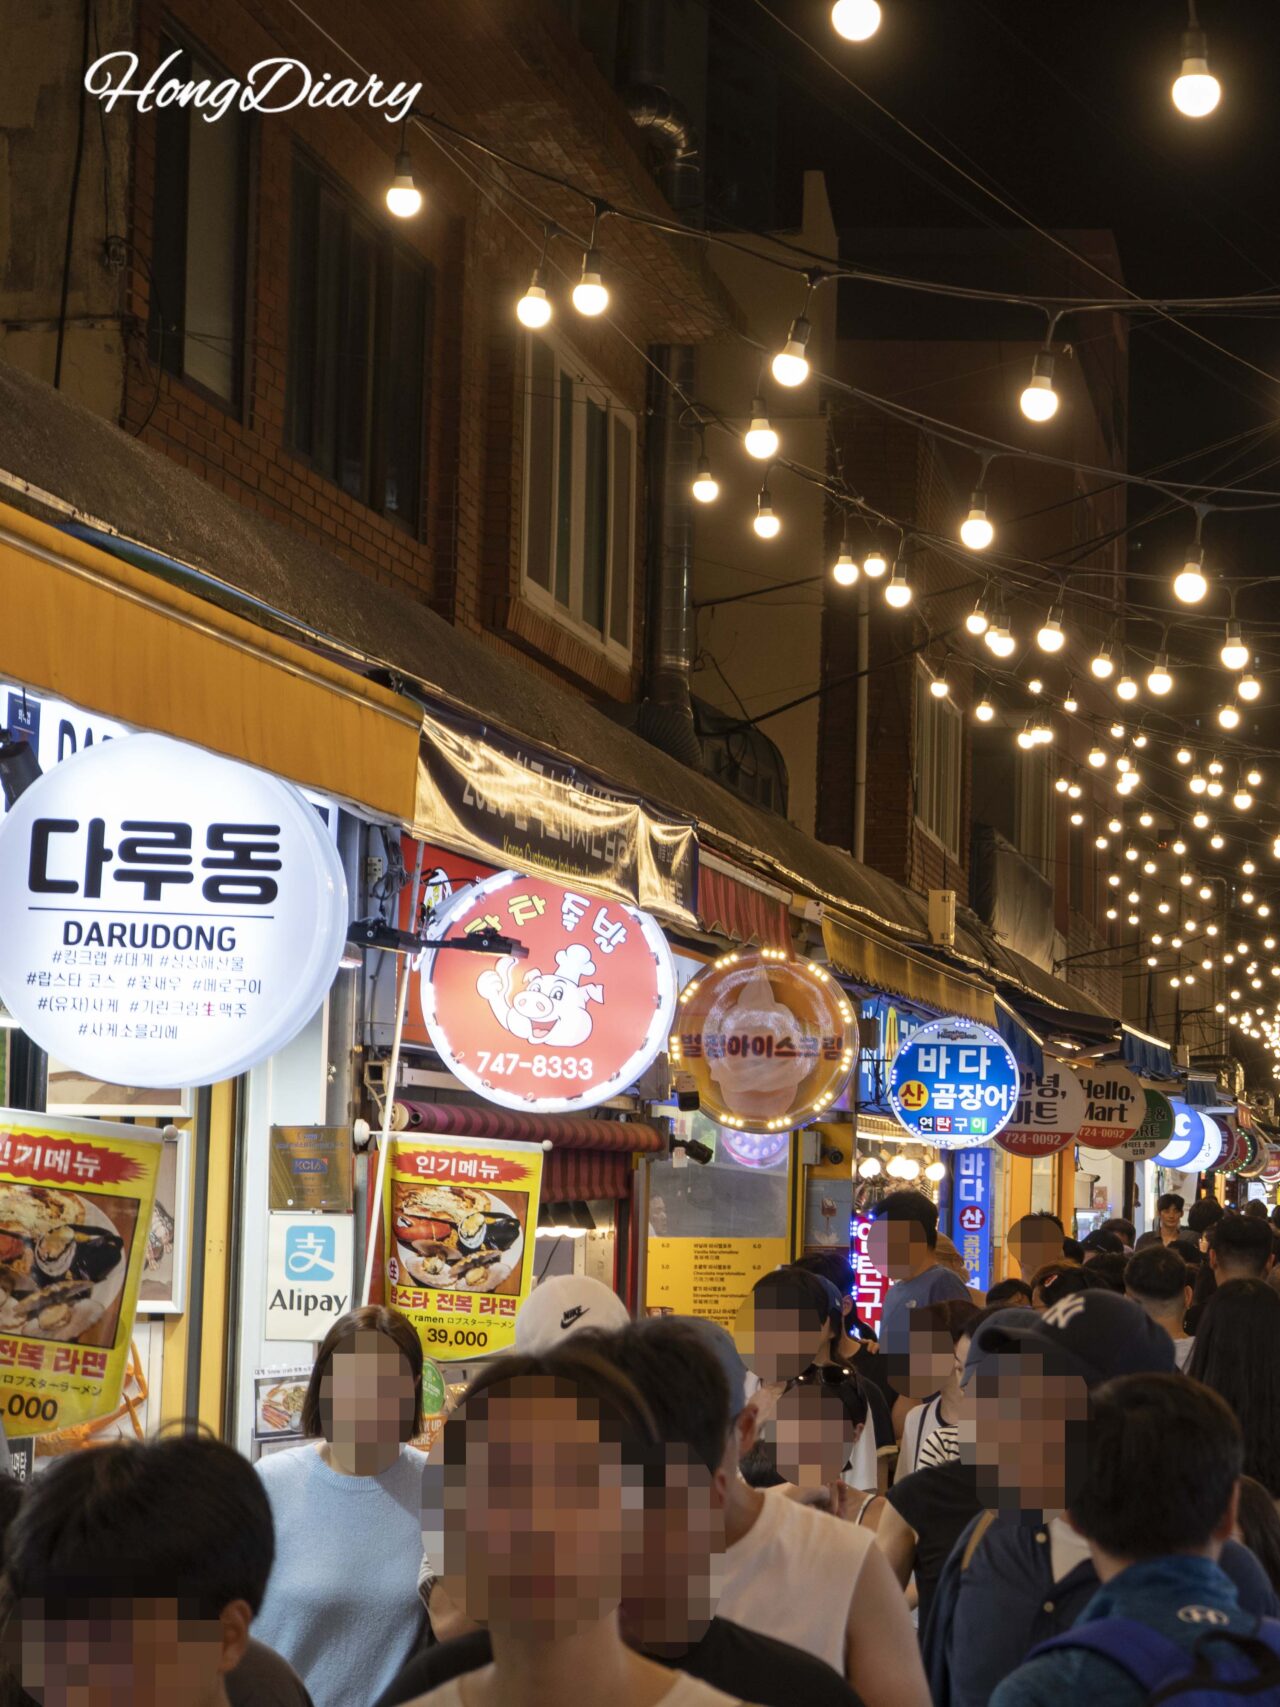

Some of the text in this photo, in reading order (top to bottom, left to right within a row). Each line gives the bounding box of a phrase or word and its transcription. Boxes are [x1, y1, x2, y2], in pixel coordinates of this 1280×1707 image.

[28, 817, 282, 905] 다루동
[62, 920, 236, 952] DARUDONG
[476, 1051, 593, 1080] 747-8333
[917, 1046, 991, 1081] 바다
[901, 1083, 1008, 1112] 산 곰장어
[919, 1116, 987, 1133] 연탄구이
[1004, 1131, 1062, 1146] 724-0092
[416, 1155, 500, 1180] 인기메뉴
[959, 1152, 985, 1203] 바다
[962, 1209, 981, 1229] 산
[269, 1290, 348, 1317] Alipay
[437, 1292, 473, 1314] 전복
[479, 1296, 516, 1317] 라면
[563, 1305, 582, 1321] NIKE
[414, 1313, 444, 1325] ramen
[427, 1328, 488, 1348] 39,000
[53, 1347, 107, 1379] 라면
